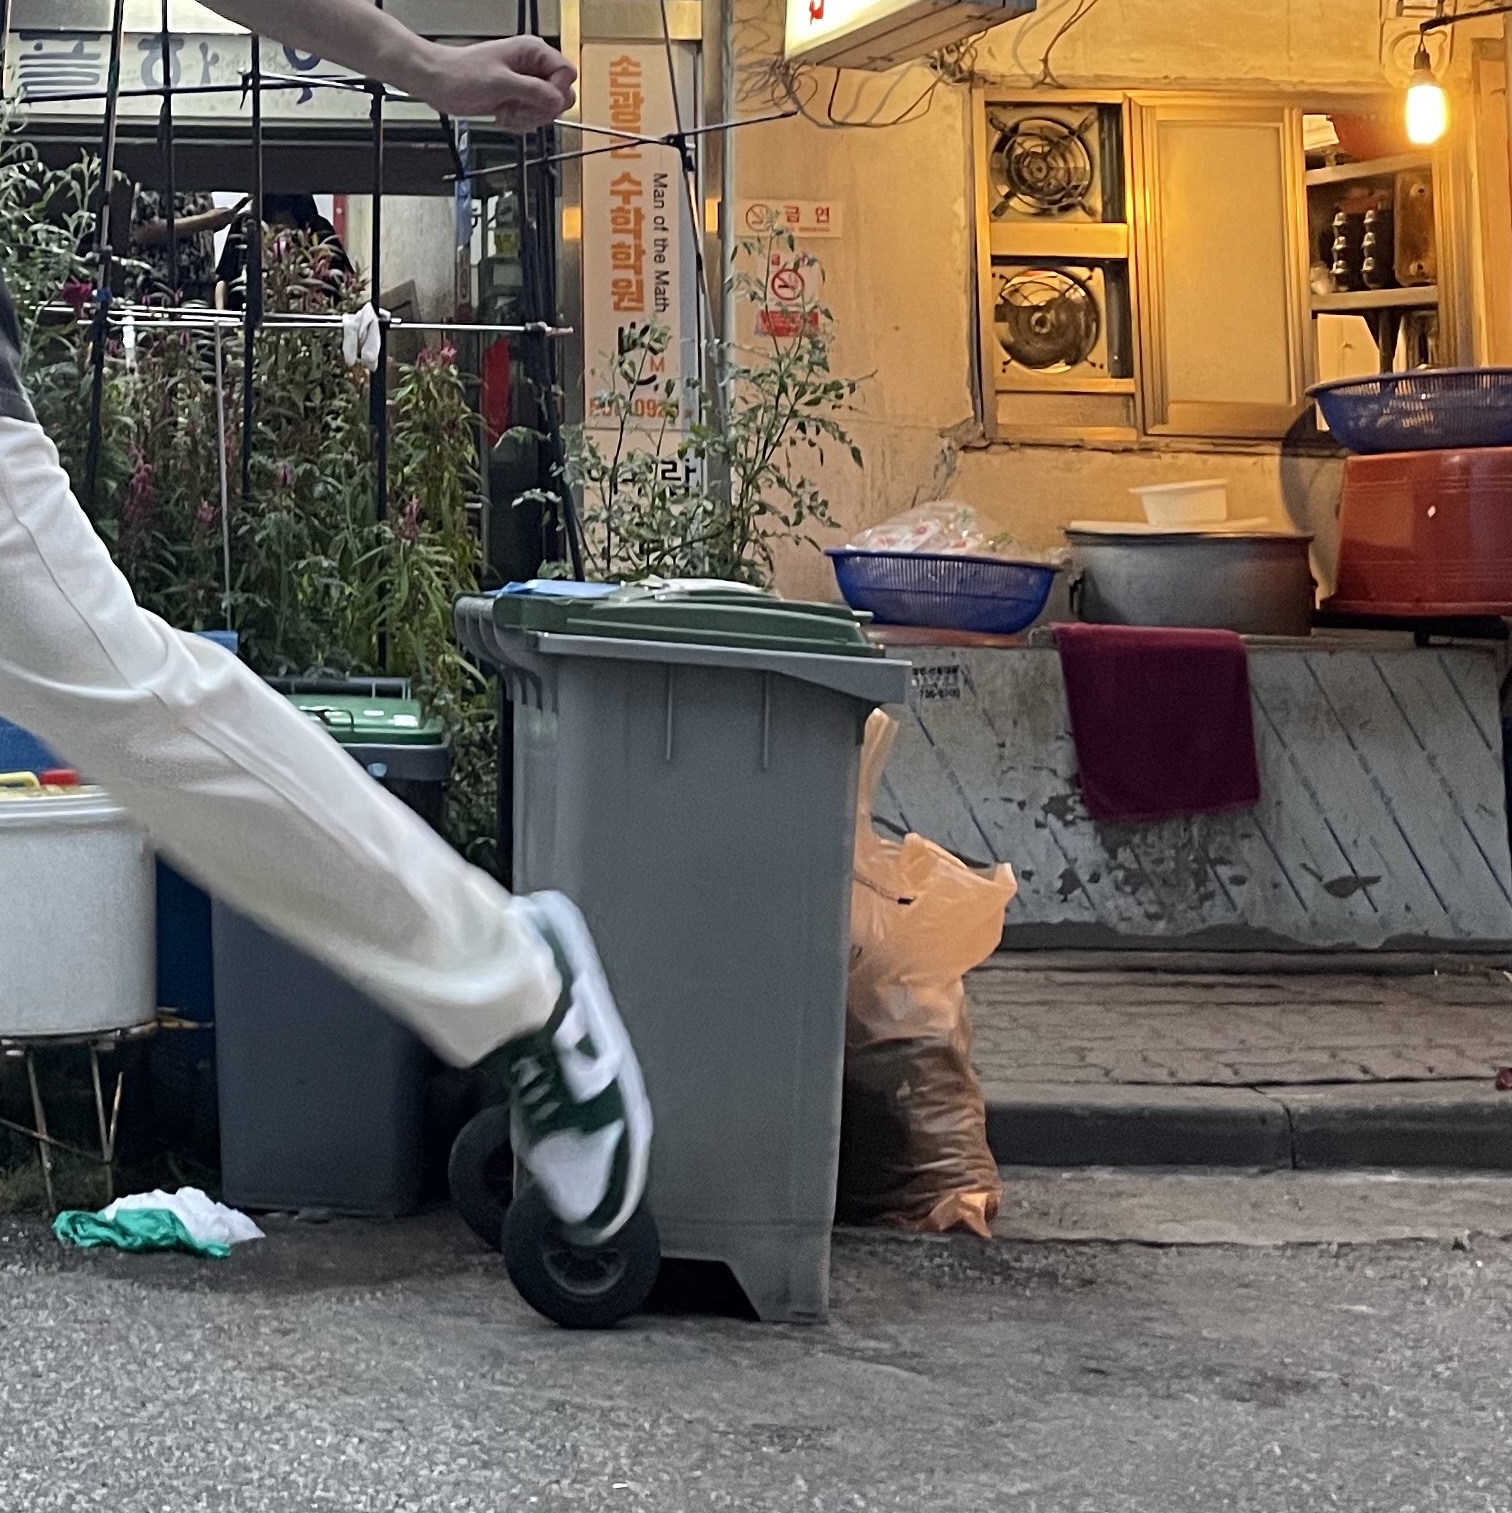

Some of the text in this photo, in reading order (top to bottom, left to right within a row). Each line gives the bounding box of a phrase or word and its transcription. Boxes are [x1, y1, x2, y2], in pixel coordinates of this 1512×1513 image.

[610, 171, 645, 313] 수학학원
[653, 173, 670, 313] Man of the Math
